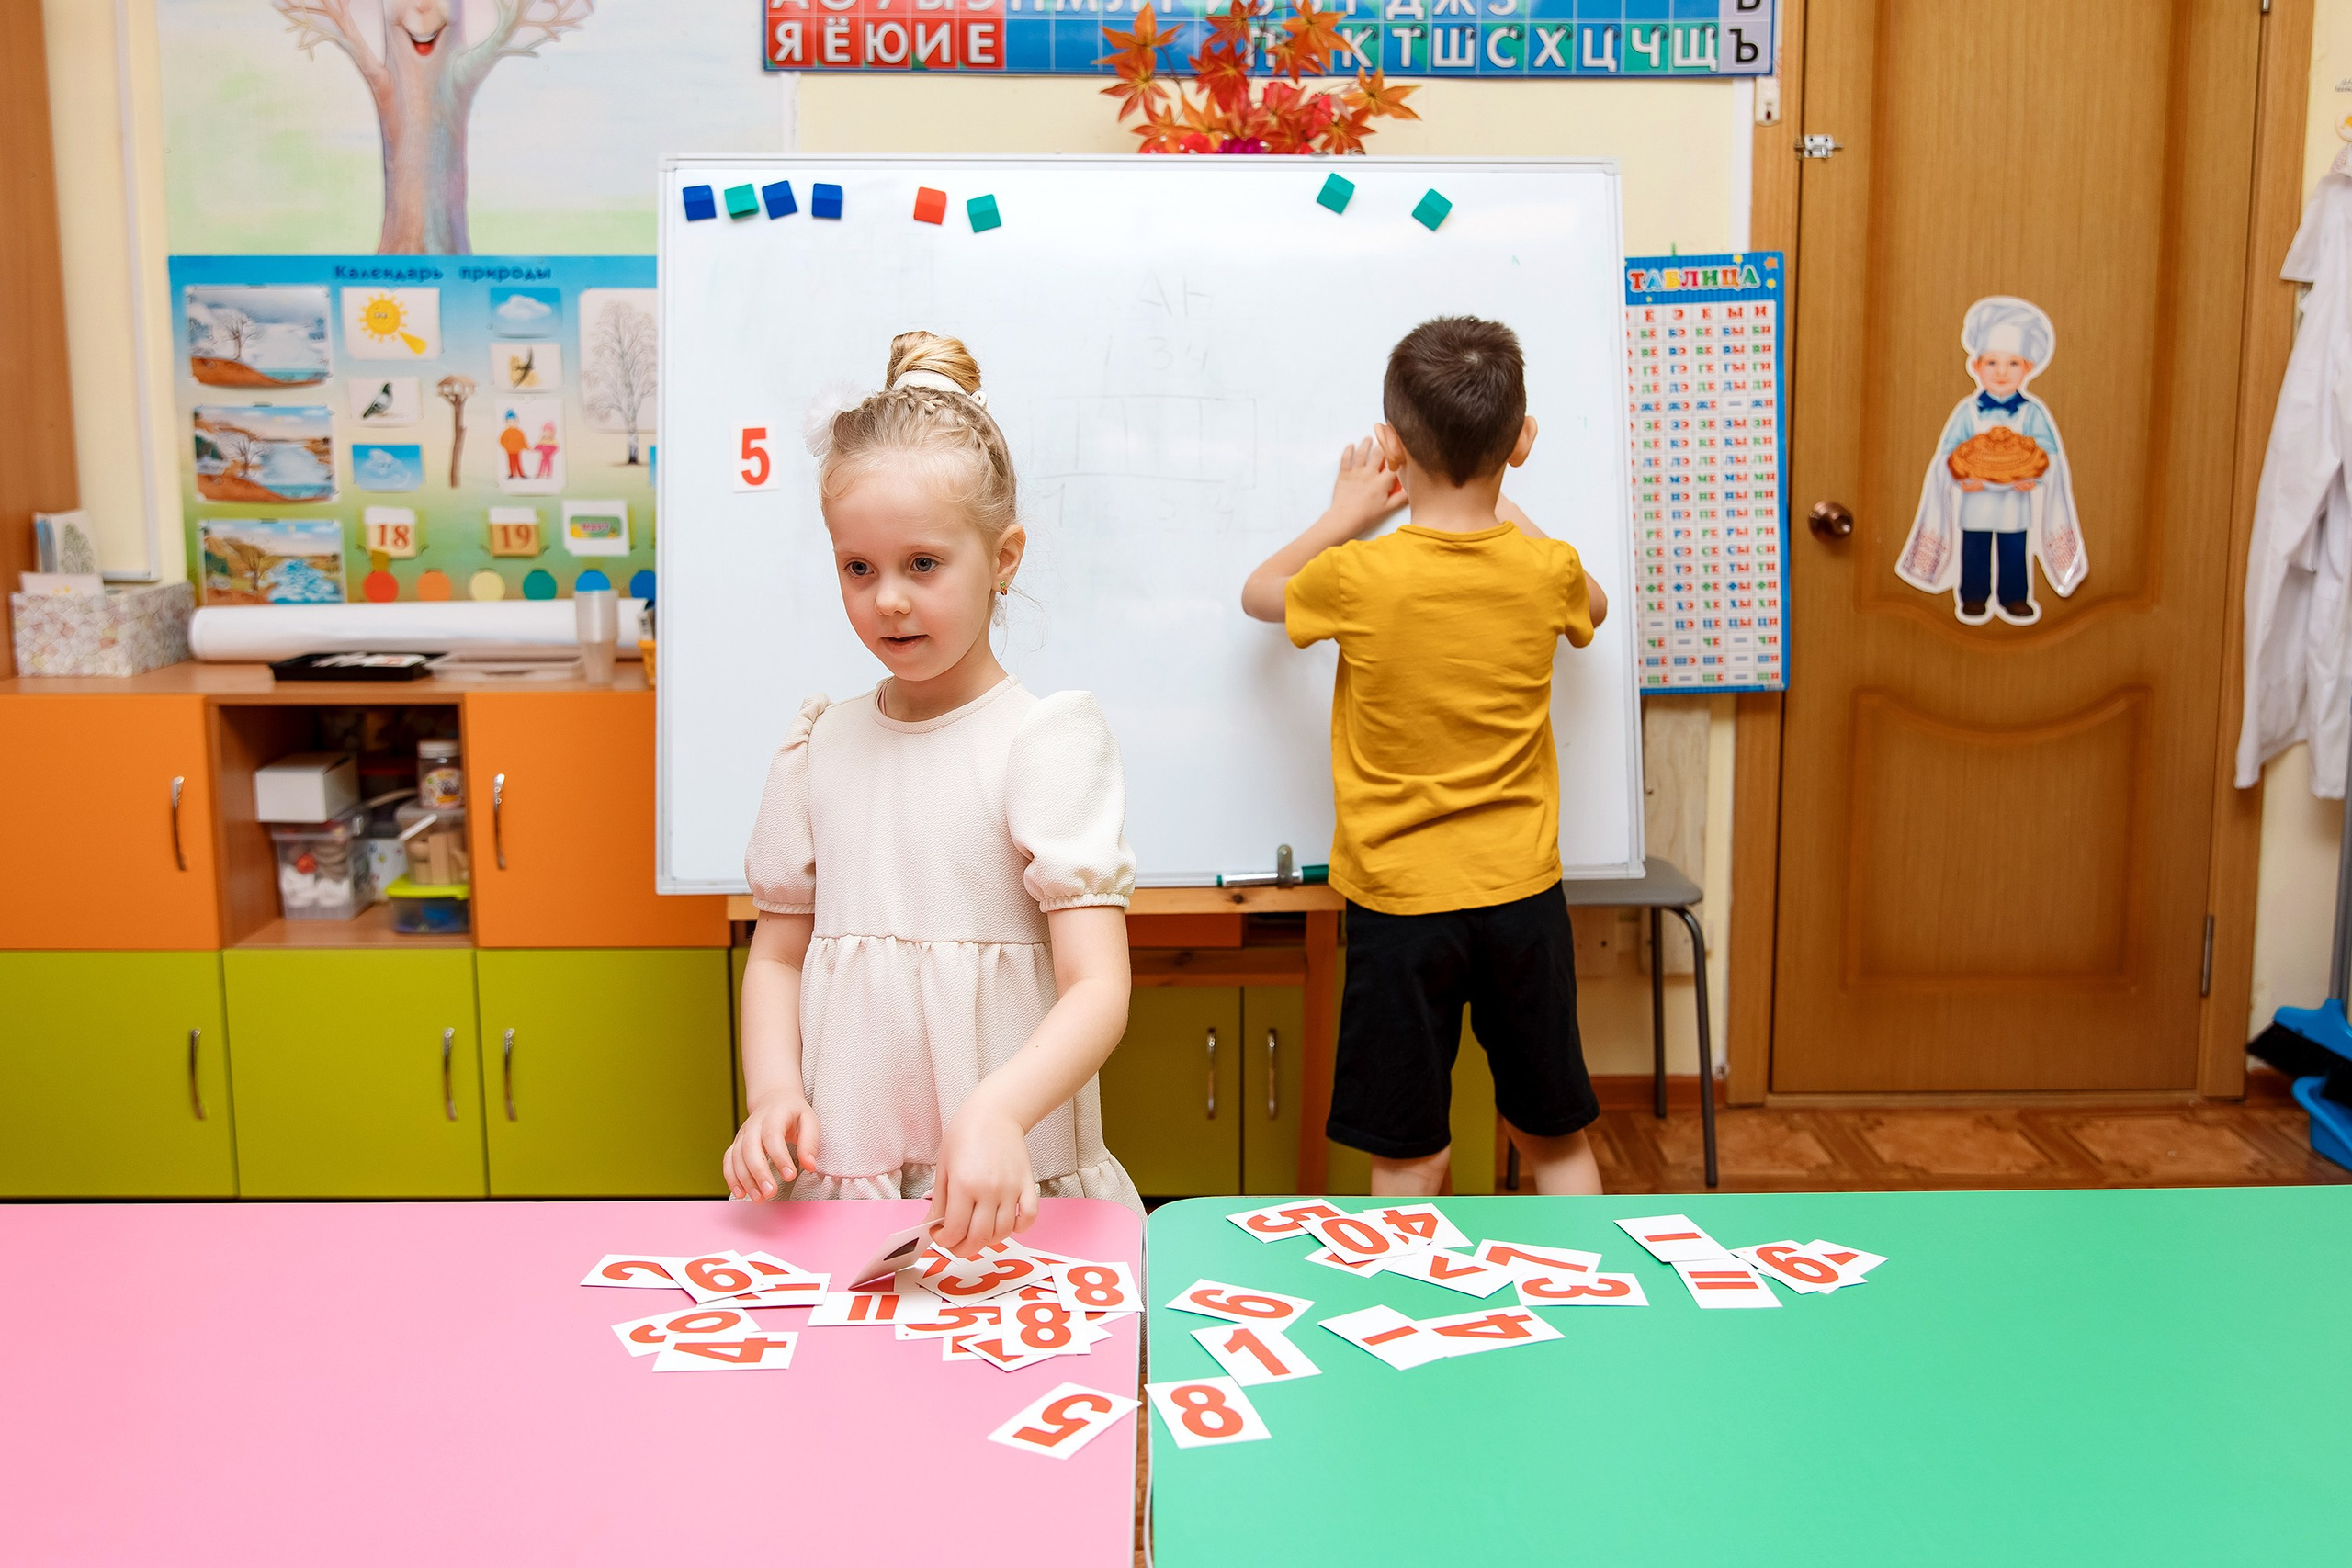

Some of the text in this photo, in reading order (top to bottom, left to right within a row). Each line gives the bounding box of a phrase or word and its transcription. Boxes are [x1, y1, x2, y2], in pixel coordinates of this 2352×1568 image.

[334, 265, 551, 282] Календарь природы
[1629, 266, 1759, 291] ТАБЛИЦА
[741, 428, 770, 485] 5
[377, 524, 411, 549] 18
[500, 524, 532, 549] 19
[1247, 1205, 1340, 1232] 5
[1382, 1209, 1438, 1239] 4
[1321, 1218, 1390, 1254] 0
[684, 1258, 752, 1292] 6
[937, 1259, 1034, 1296] 3
[1067, 1266, 1125, 1306] 8
[1522, 1277, 1631, 1298] 3
[666, 1311, 741, 1333] 0
[1016, 1303, 1072, 1348] 8
[1431, 1314, 1533, 1339] 4
[673, 1337, 787, 1363] 4
[1224, 1328, 1292, 1376] 1
[1012, 1393, 1113, 1447] 5
[1170, 1384, 1244, 1438] 8
